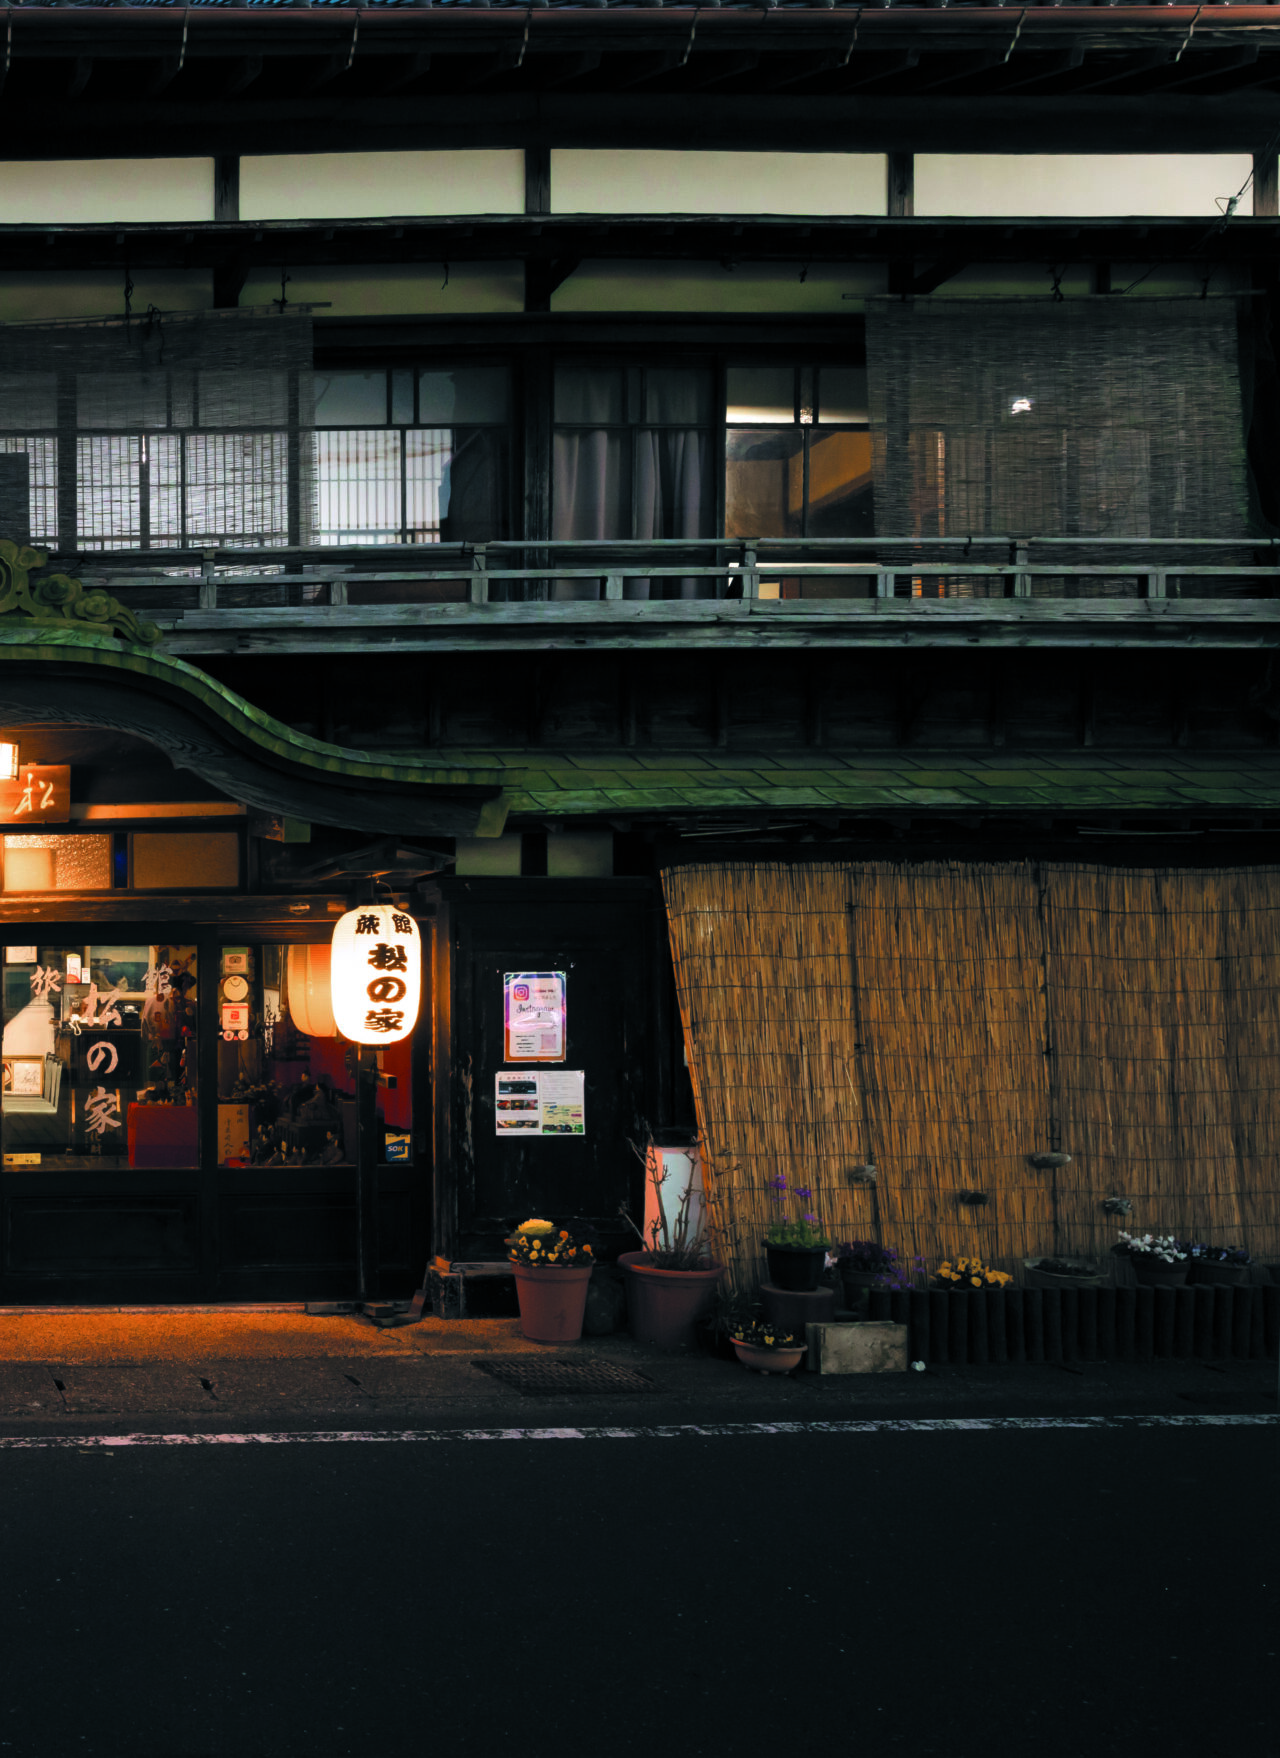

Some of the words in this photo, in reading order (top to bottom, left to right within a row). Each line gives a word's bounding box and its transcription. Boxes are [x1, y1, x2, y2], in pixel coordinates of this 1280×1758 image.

[354, 913, 414, 936] 旅館
[365, 942, 408, 1033] 松の家
[81, 981, 123, 1135] 松の家
